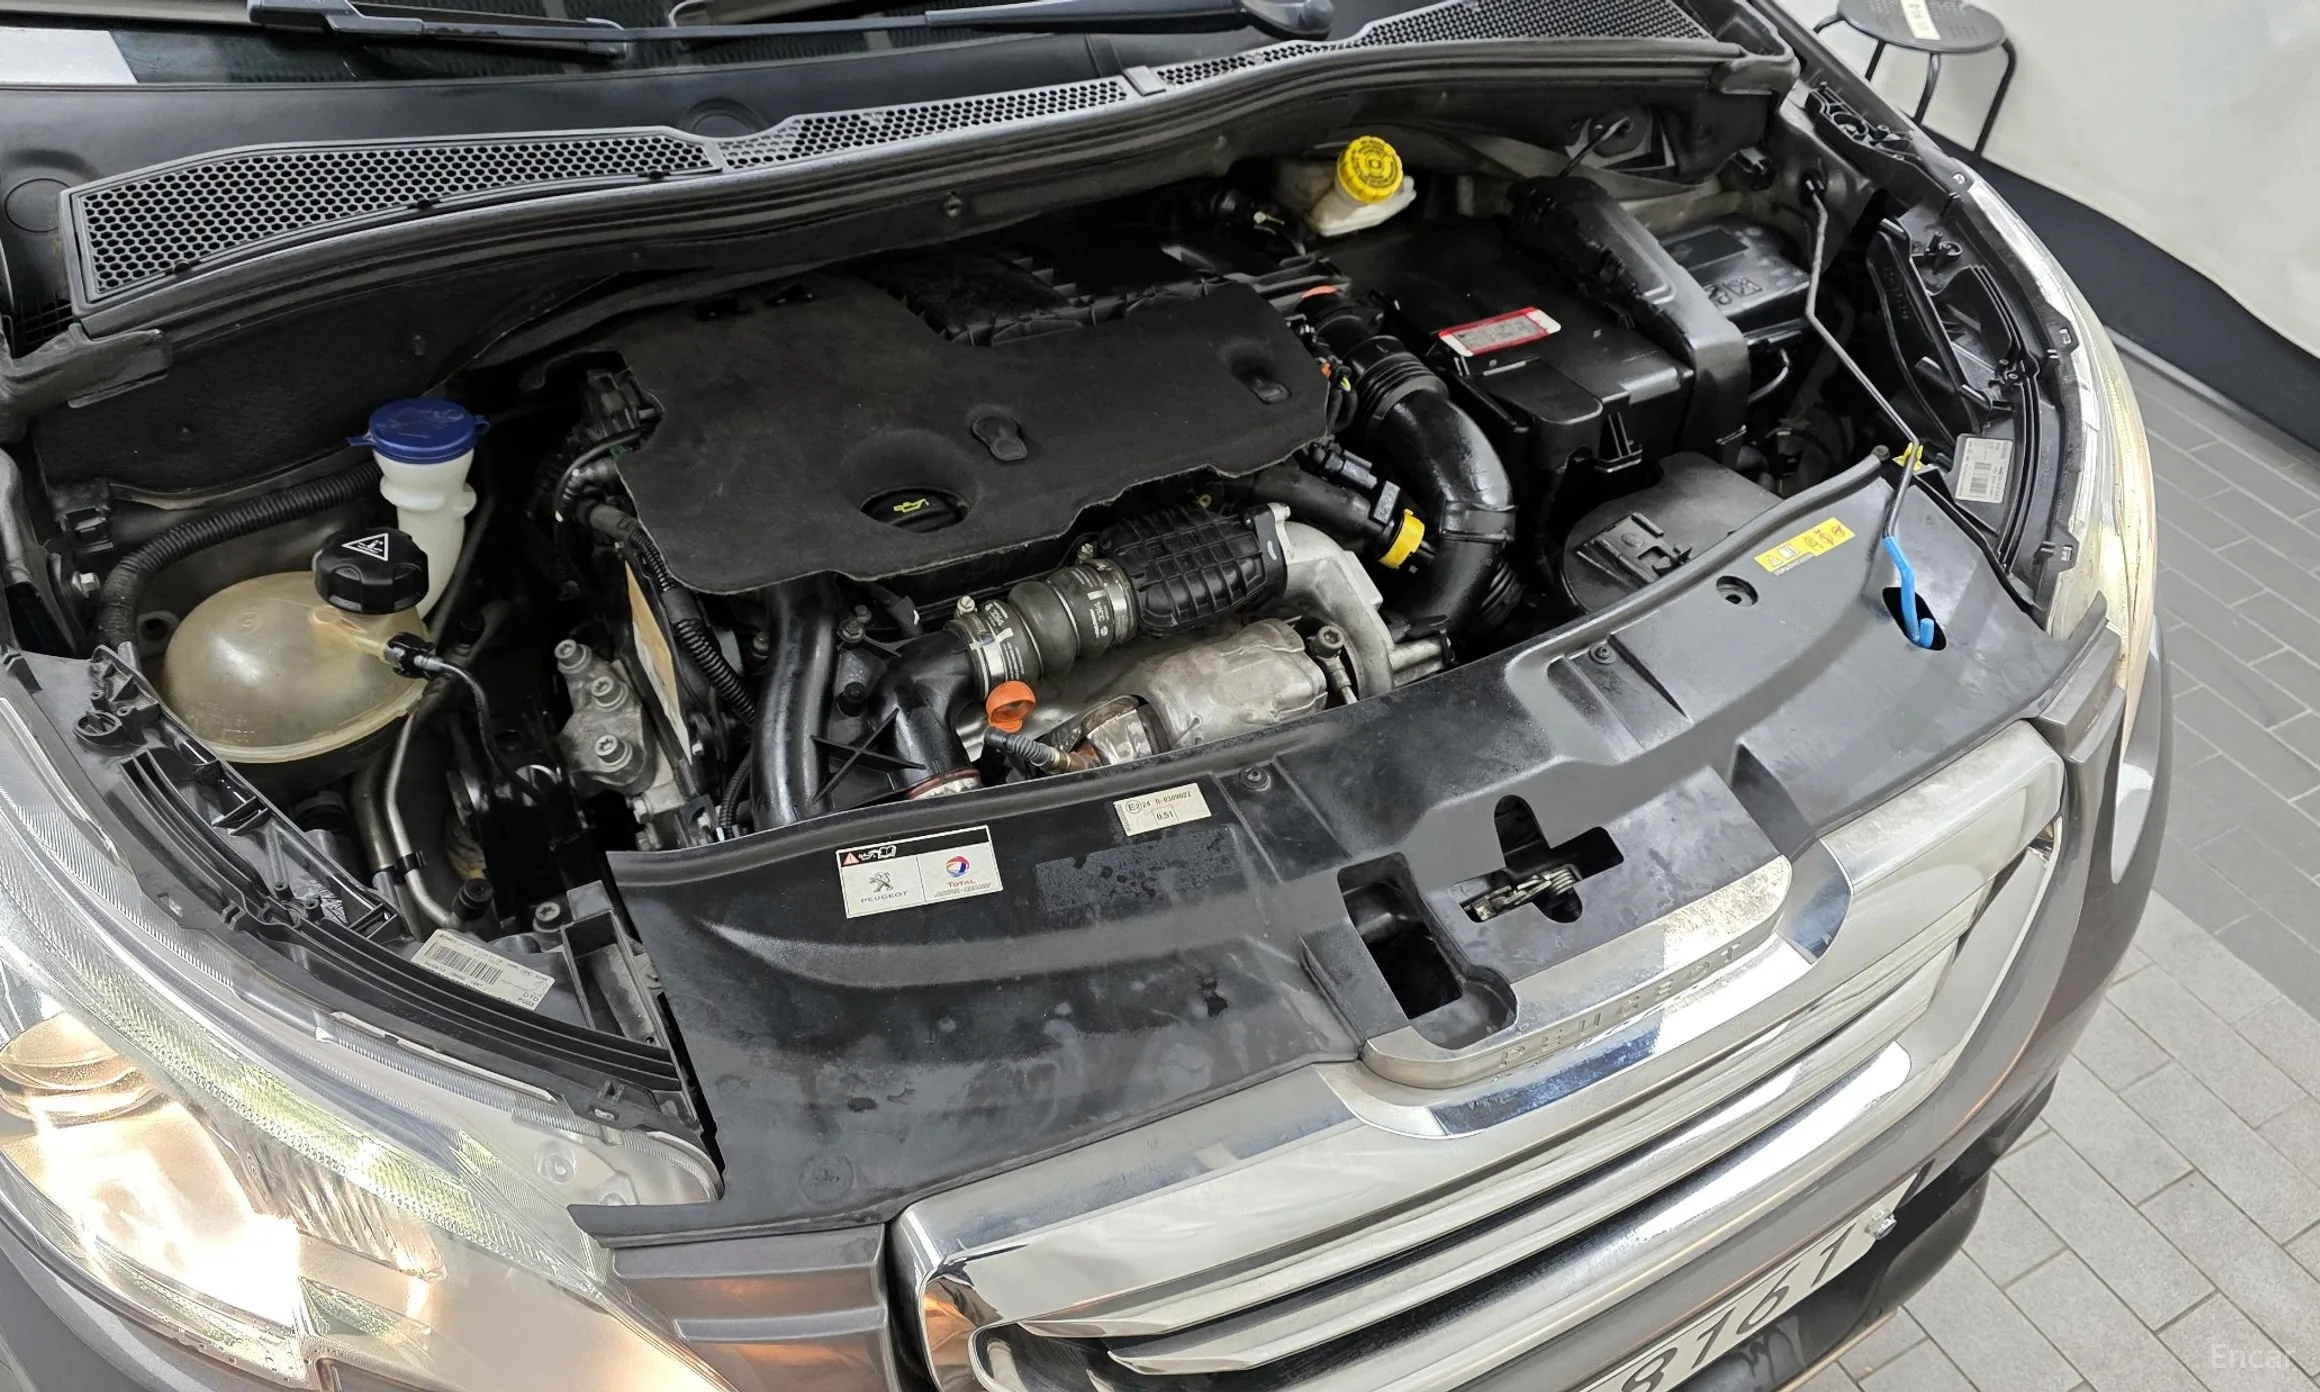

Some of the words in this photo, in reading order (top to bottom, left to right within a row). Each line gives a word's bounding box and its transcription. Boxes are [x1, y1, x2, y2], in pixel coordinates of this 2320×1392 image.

[948, 880, 976, 888] TOTAL
[861, 890, 908, 903] PEUGEOT
[1500, 941, 1741, 1069] PEUGEOT
